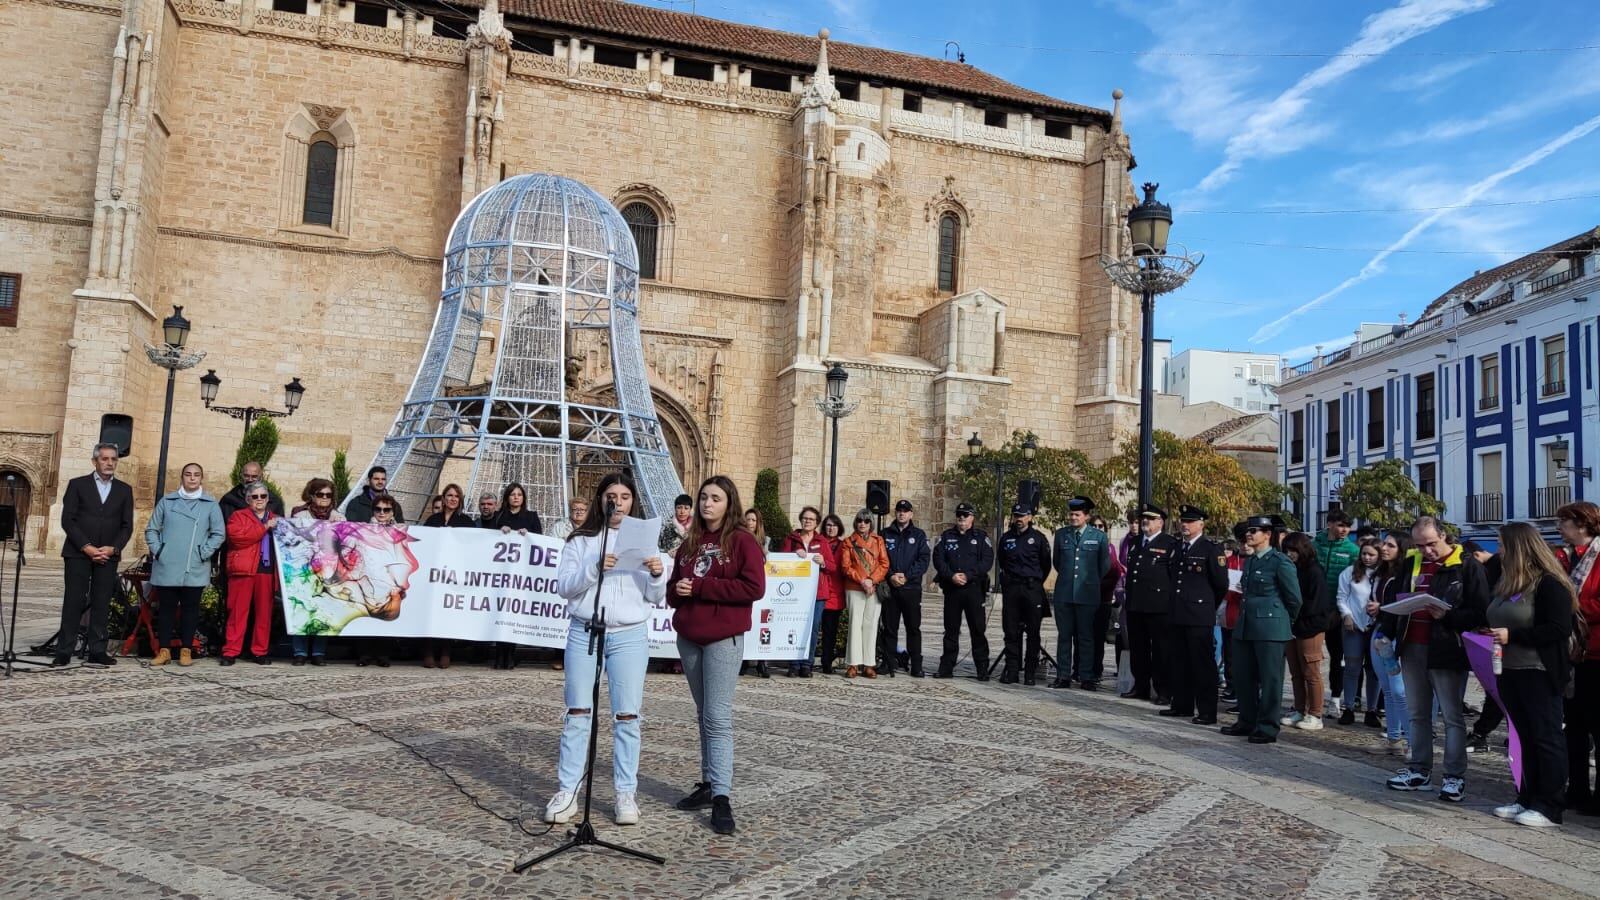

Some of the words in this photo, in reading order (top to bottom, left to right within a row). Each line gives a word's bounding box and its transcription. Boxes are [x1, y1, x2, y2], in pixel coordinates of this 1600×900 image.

[492, 541, 521, 563] 25
[528, 544, 559, 568] DE
[429, 565, 458, 585] DÍA
[443, 593, 465, 610] DE
[470, 595, 491, 612] LA
[653, 618, 672, 632] LA
